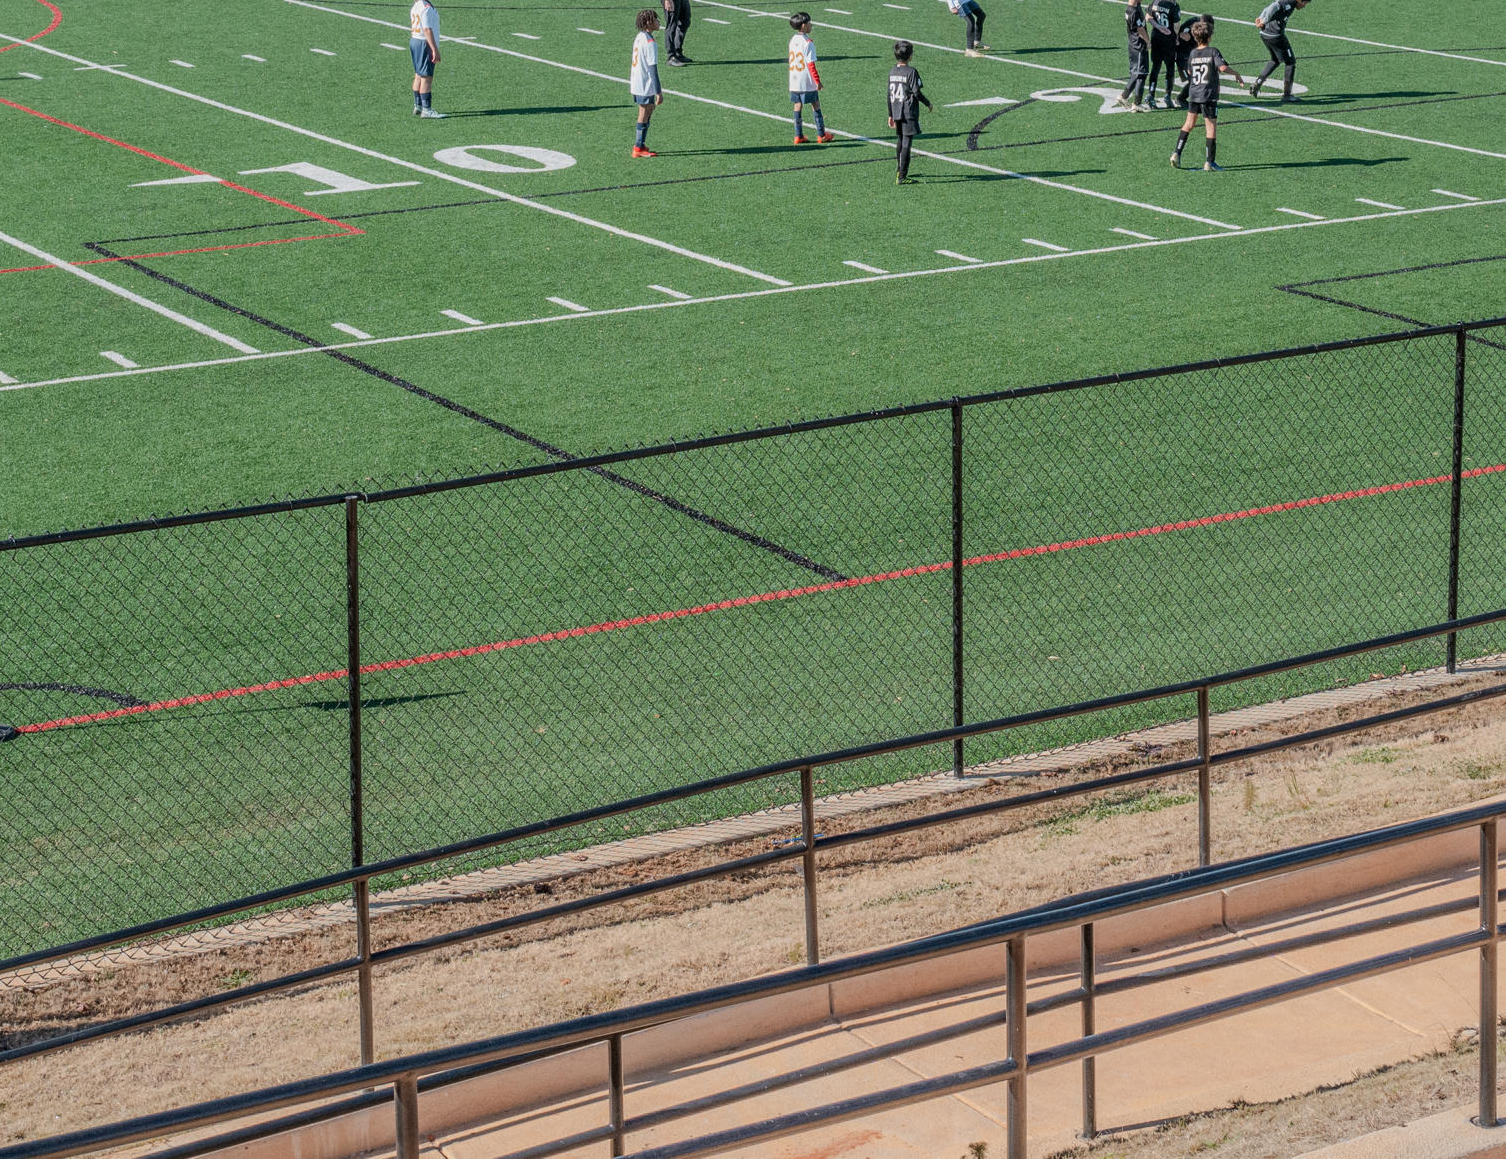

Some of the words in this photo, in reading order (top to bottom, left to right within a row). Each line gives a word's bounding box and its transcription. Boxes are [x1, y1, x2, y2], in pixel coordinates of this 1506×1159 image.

[789, 50, 805, 72] 23
[1192, 64, 1208, 85] 52
[889, 82, 904, 103] 34
[237, 144, 577, 196] 10
